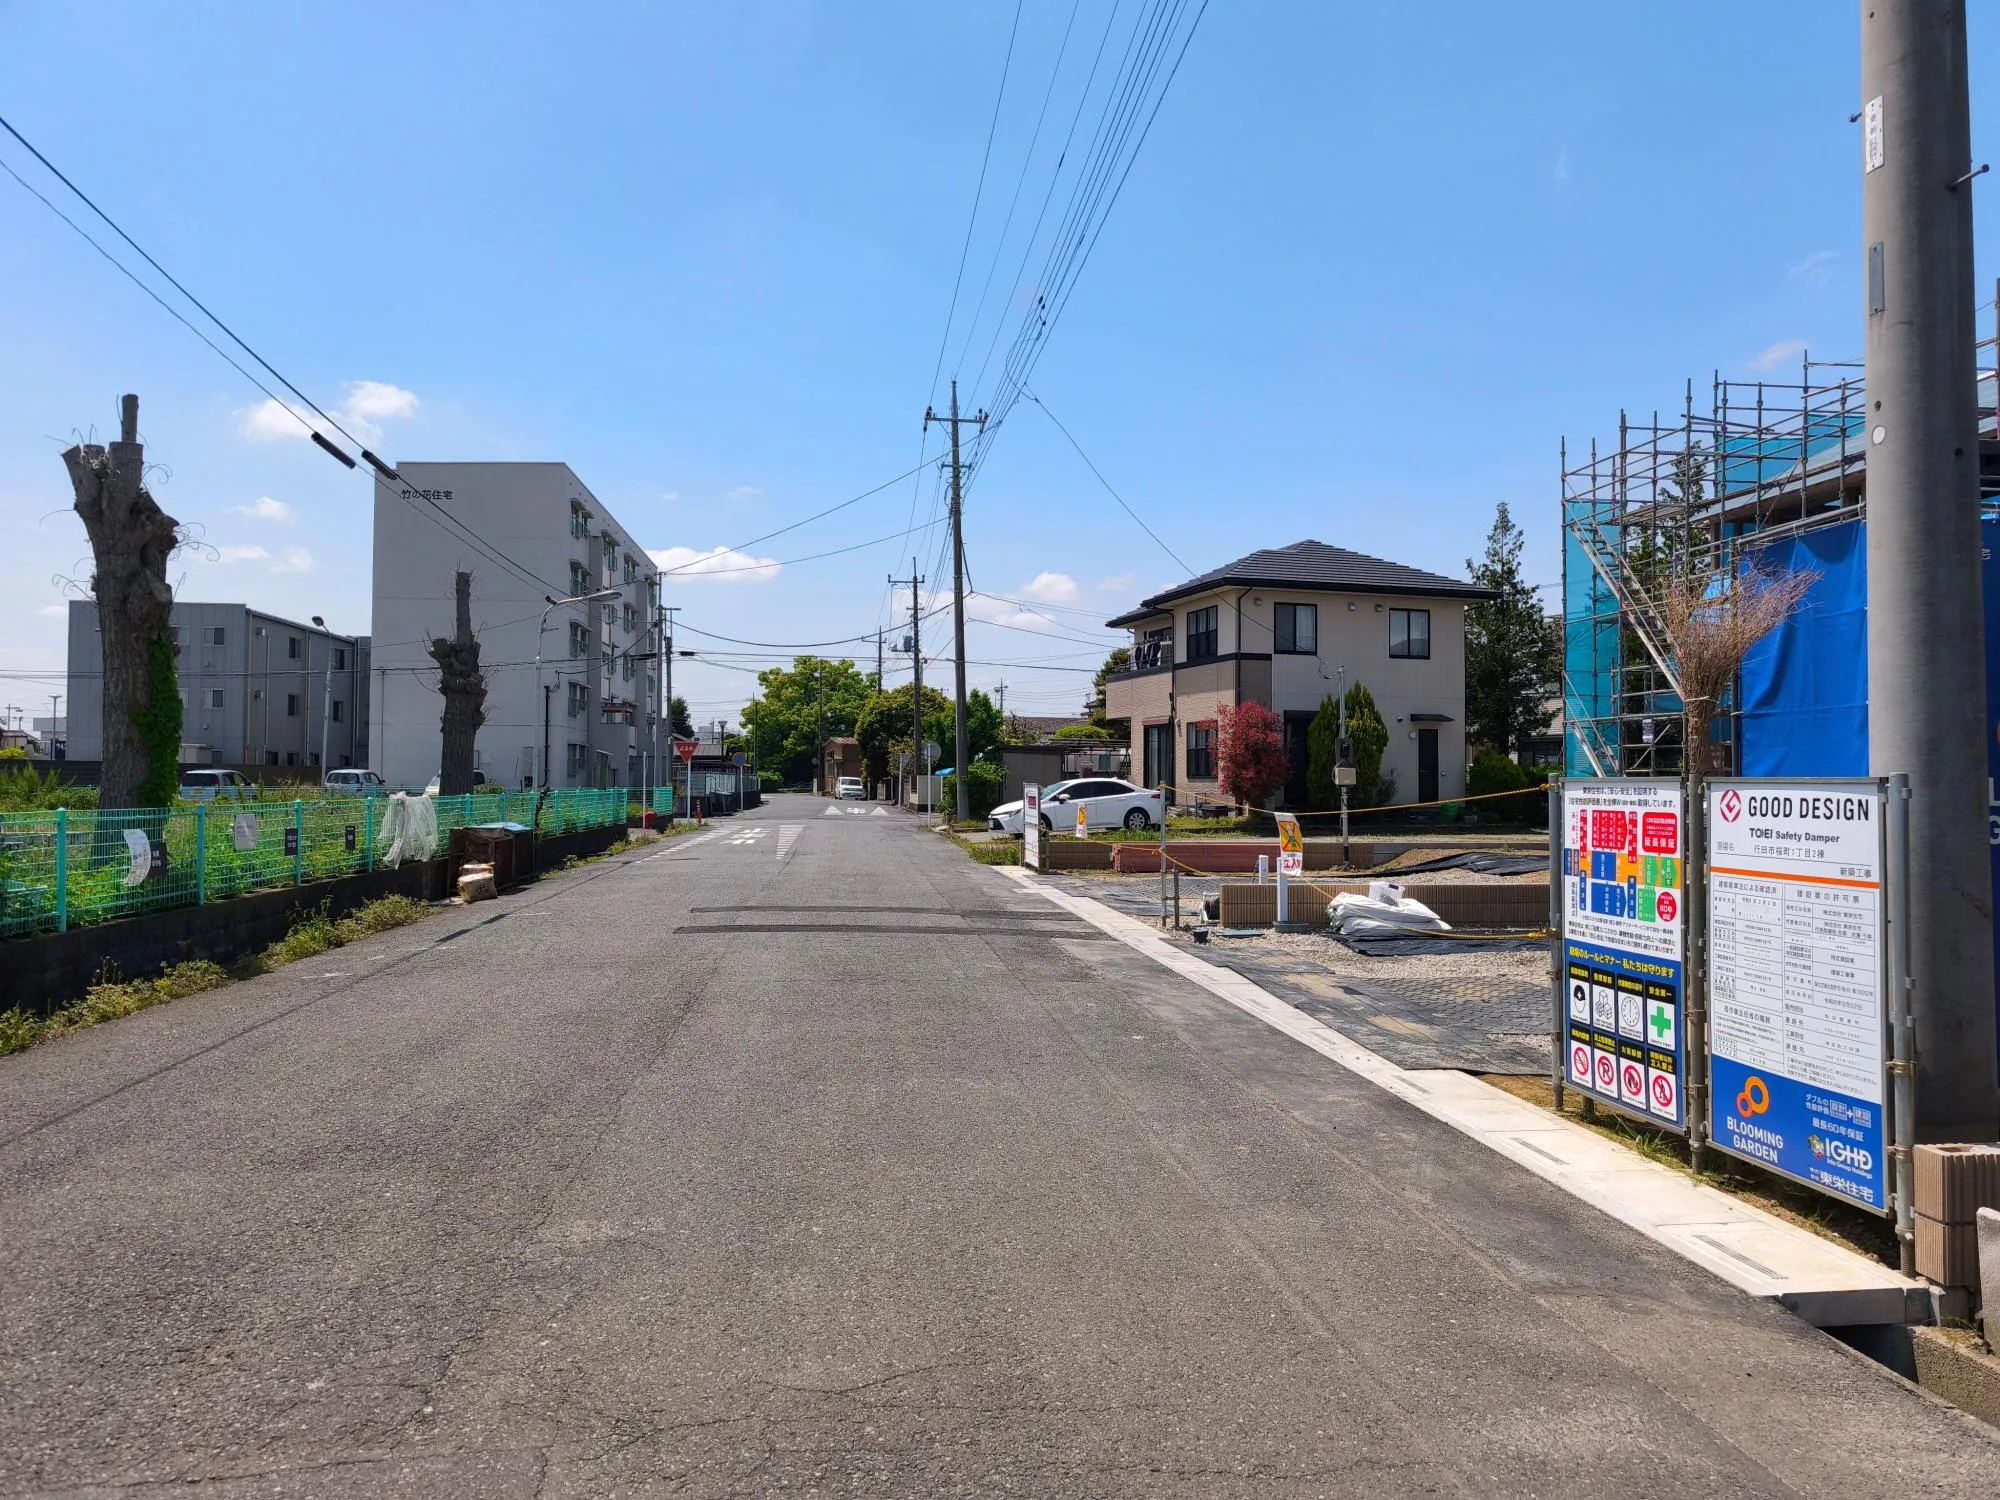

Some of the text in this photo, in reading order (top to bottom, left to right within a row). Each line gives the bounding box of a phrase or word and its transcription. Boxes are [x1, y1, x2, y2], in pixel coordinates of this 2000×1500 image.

[401, 489, 453, 500] 竹の花住宅
[1748, 796, 1869, 821] GOOD DESIGN
[1775, 830, 1802, 843] Safety
[1804, 832, 1840, 844] Damper
[1716, 841, 1735, 852] 現場名
[1753, 844, 1825, 859] 行田市桜町1丁目2棟
[1840, 867, 1872, 878] 新築工事
[1718, 880, 1777, 895] 建築基準法による確認済
[1796, 889, 1860, 904] 建設業の許可票
[1622, 958, 1675, 978] 私たちは守ります
[1649, 987, 1672, 997] 安全第一
[1785, 1042, 1805, 1053] 連絡先
[1650, 1060, 1673, 1072] 立入禁止
[1806, 1093, 1829, 1106] ダブルの
[1831, 1101, 1846, 1113] 設計
[1854, 1108, 1870, 1120] 建設
[1727, 1116, 1784, 1149] BLOOMING
[1812, 1117, 1864, 1141] 最長60年保証
[1733, 1134, 1778, 1163] GARDEN
[1820, 1171, 1873, 1202] 東栄住宅
